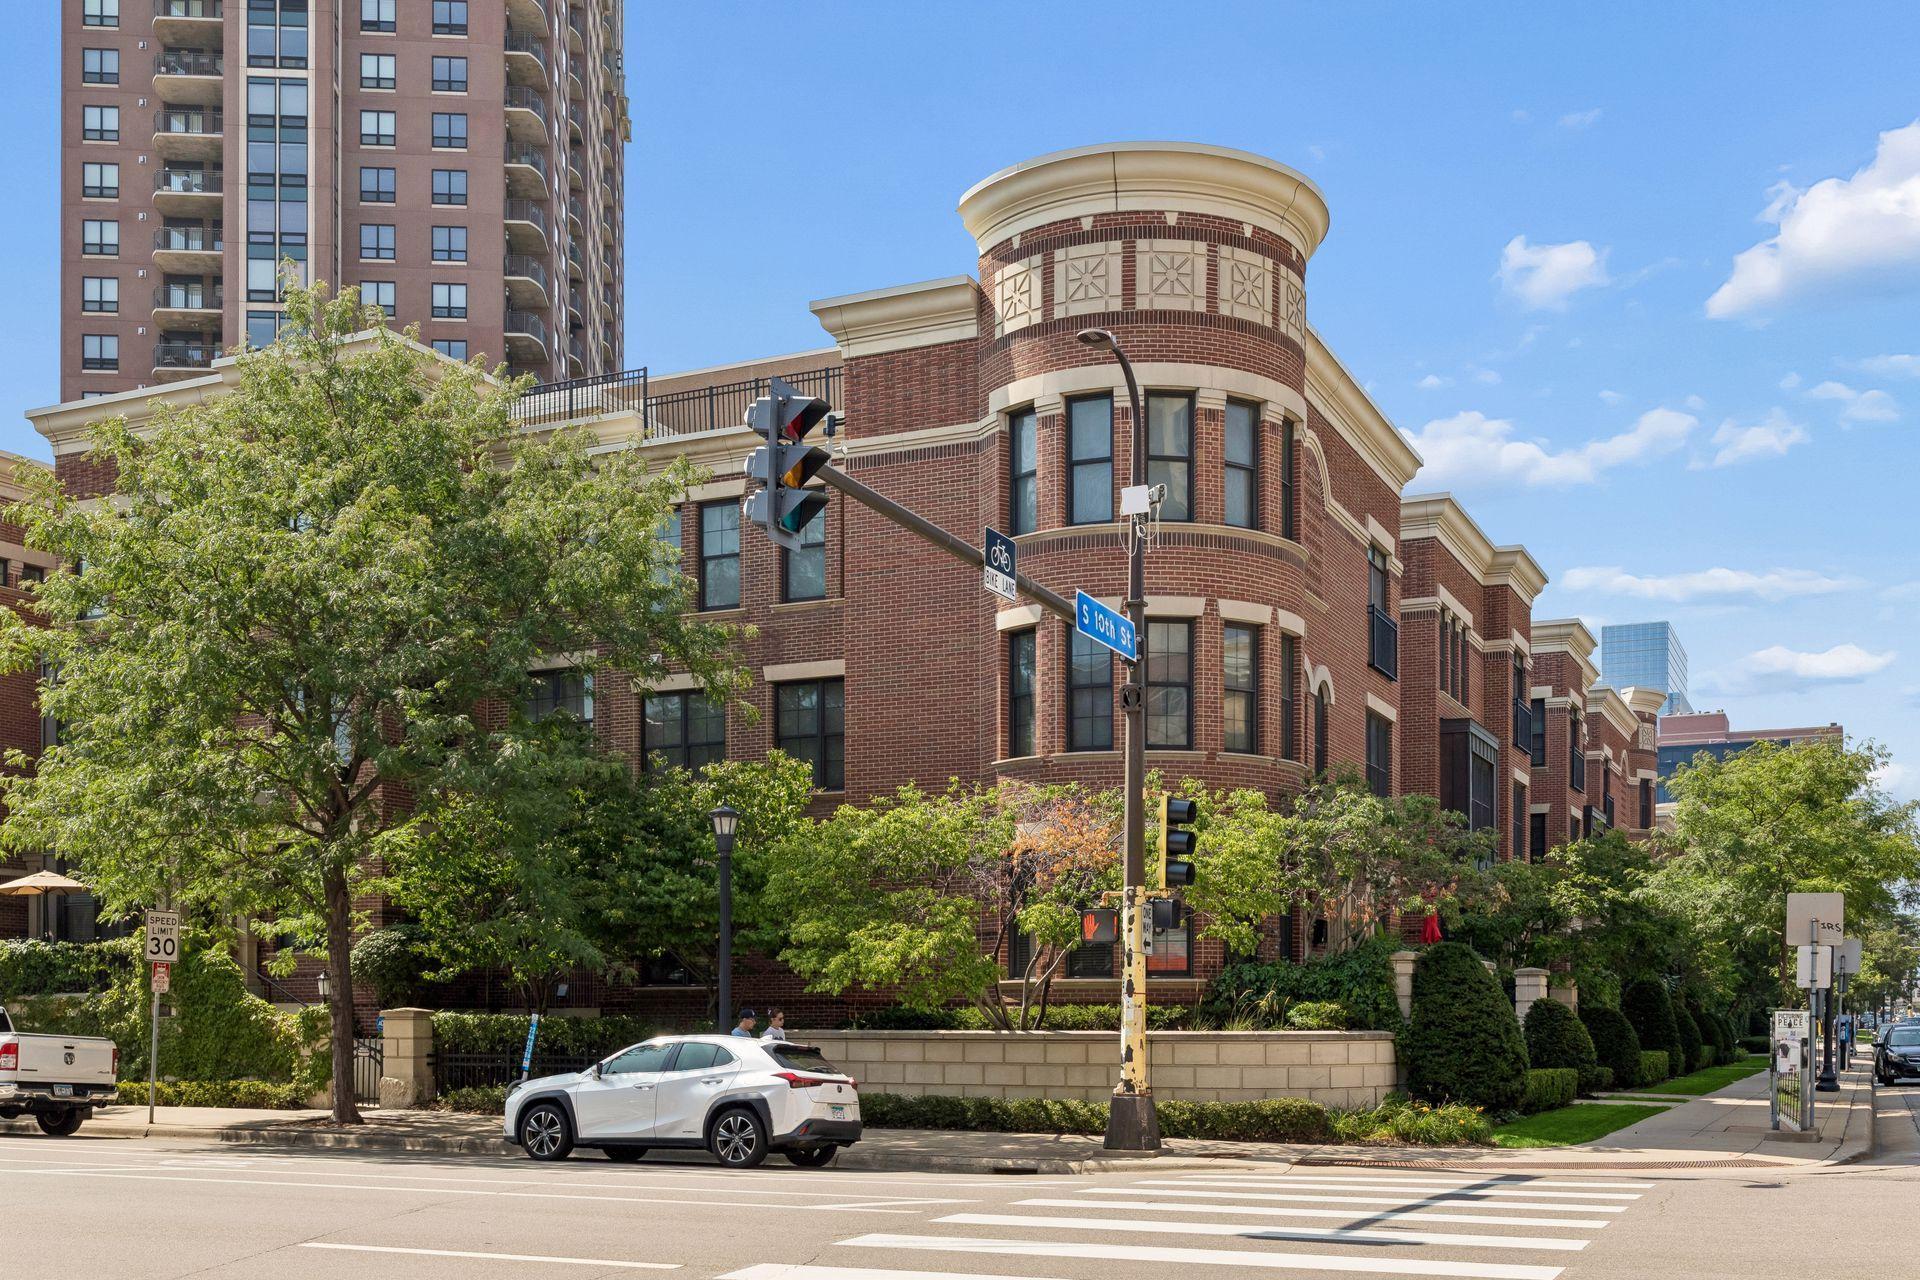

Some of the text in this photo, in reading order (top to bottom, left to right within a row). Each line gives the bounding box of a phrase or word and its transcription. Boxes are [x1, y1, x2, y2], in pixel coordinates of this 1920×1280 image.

[986, 569, 1015, 597] BIKE LANE
[1082, 603, 1131, 649] S 10th St
[149, 916, 177, 926] SPEED
[152, 927, 174, 936] LIMIT
[149, 937, 175, 956] 30
